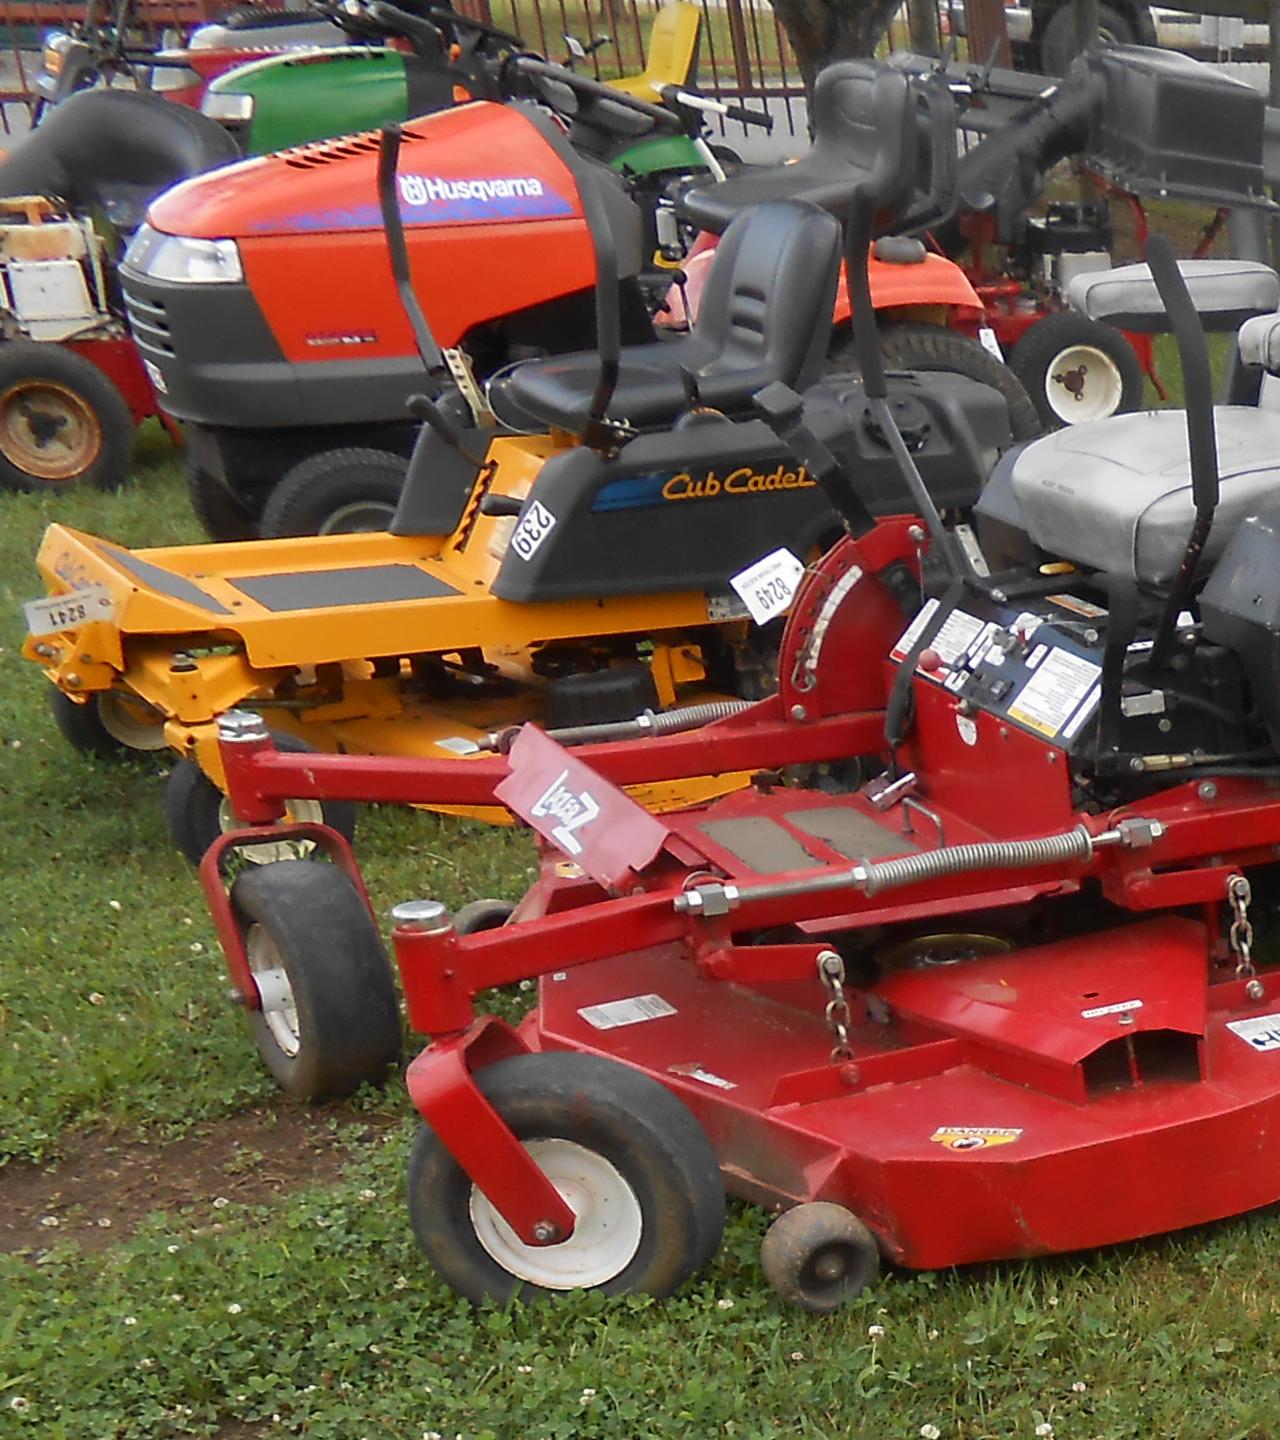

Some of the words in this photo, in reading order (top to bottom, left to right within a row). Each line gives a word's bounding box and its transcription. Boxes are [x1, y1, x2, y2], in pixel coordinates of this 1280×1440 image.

[425, 178, 544, 202] Husqvarna
[662, 472, 721, 500] Cub
[516, 505, 551, 555] 239
[755, 577, 791, 610] 8249
